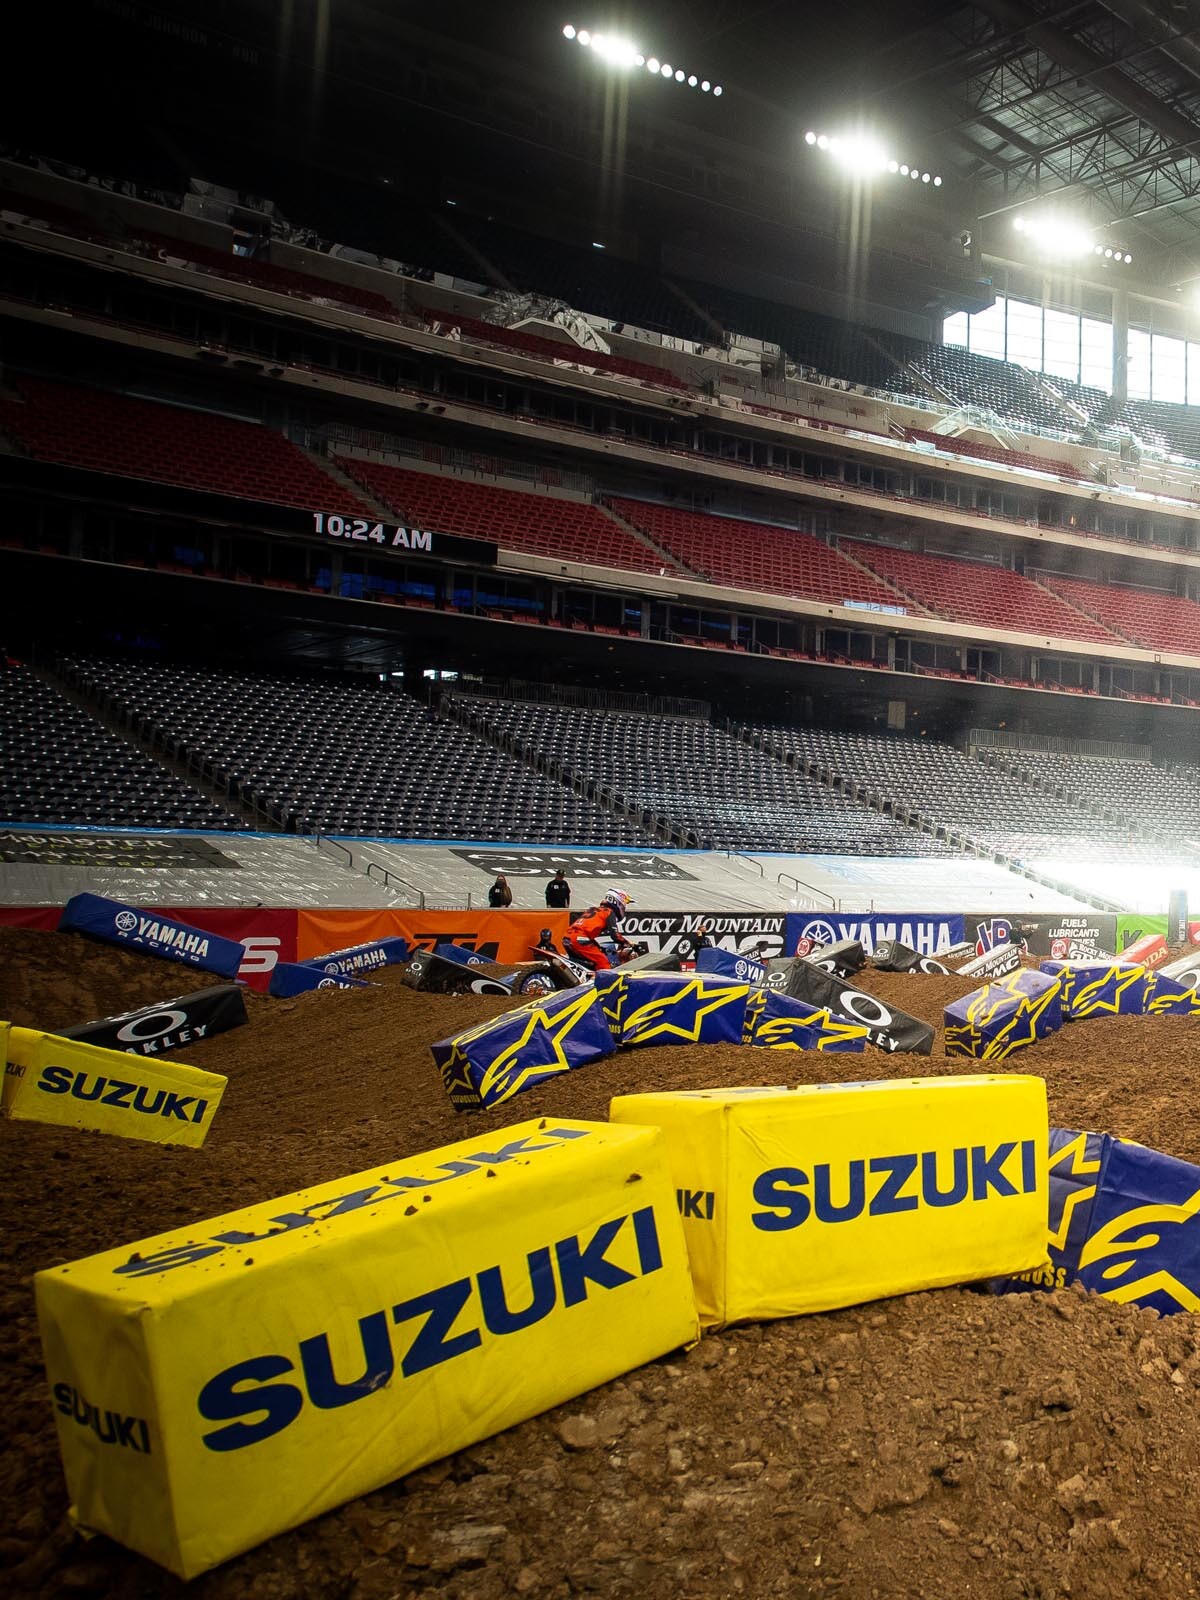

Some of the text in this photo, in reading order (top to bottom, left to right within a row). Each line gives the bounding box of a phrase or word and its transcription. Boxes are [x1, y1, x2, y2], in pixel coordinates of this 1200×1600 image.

[313, 513, 433, 551] 10:24 AM
[138, 917, 209, 958] YAMAHA
[616, 915, 784, 934] ROCKY MOUNTAIN
[1048, 928, 1100, 938] LUBRICANTS
[1061, 919, 1088, 928] FUELS
[117, 930, 200, 962] RACING
[839, 922, 950, 957] YAMAHA
[1078, 943, 1098, 955] ROCKY
[337, 948, 387, 973] YAMAHA
[569, 961, 584, 981] 25
[747, 964, 764, 981] YAM
[985, 947, 1018, 972] MOUNTAIN
[1143, 946, 1168, 969] NDA
[125, 1024, 208, 1055] AKLEY
[822, 1005, 900, 1051] OLEY
[5, 1062, 26, 1078] ZUKI
[37, 1065, 209, 1124] SUZUKI
[751, 1139, 1037, 1233] SUZUKI
[112, 1128, 593, 1278] SUZUKI
[677, 1190, 715, 1222] UKI
[196, 1206, 664, 1453] SUZUKI
[52, 1381, 153, 1455] SUZUKI
